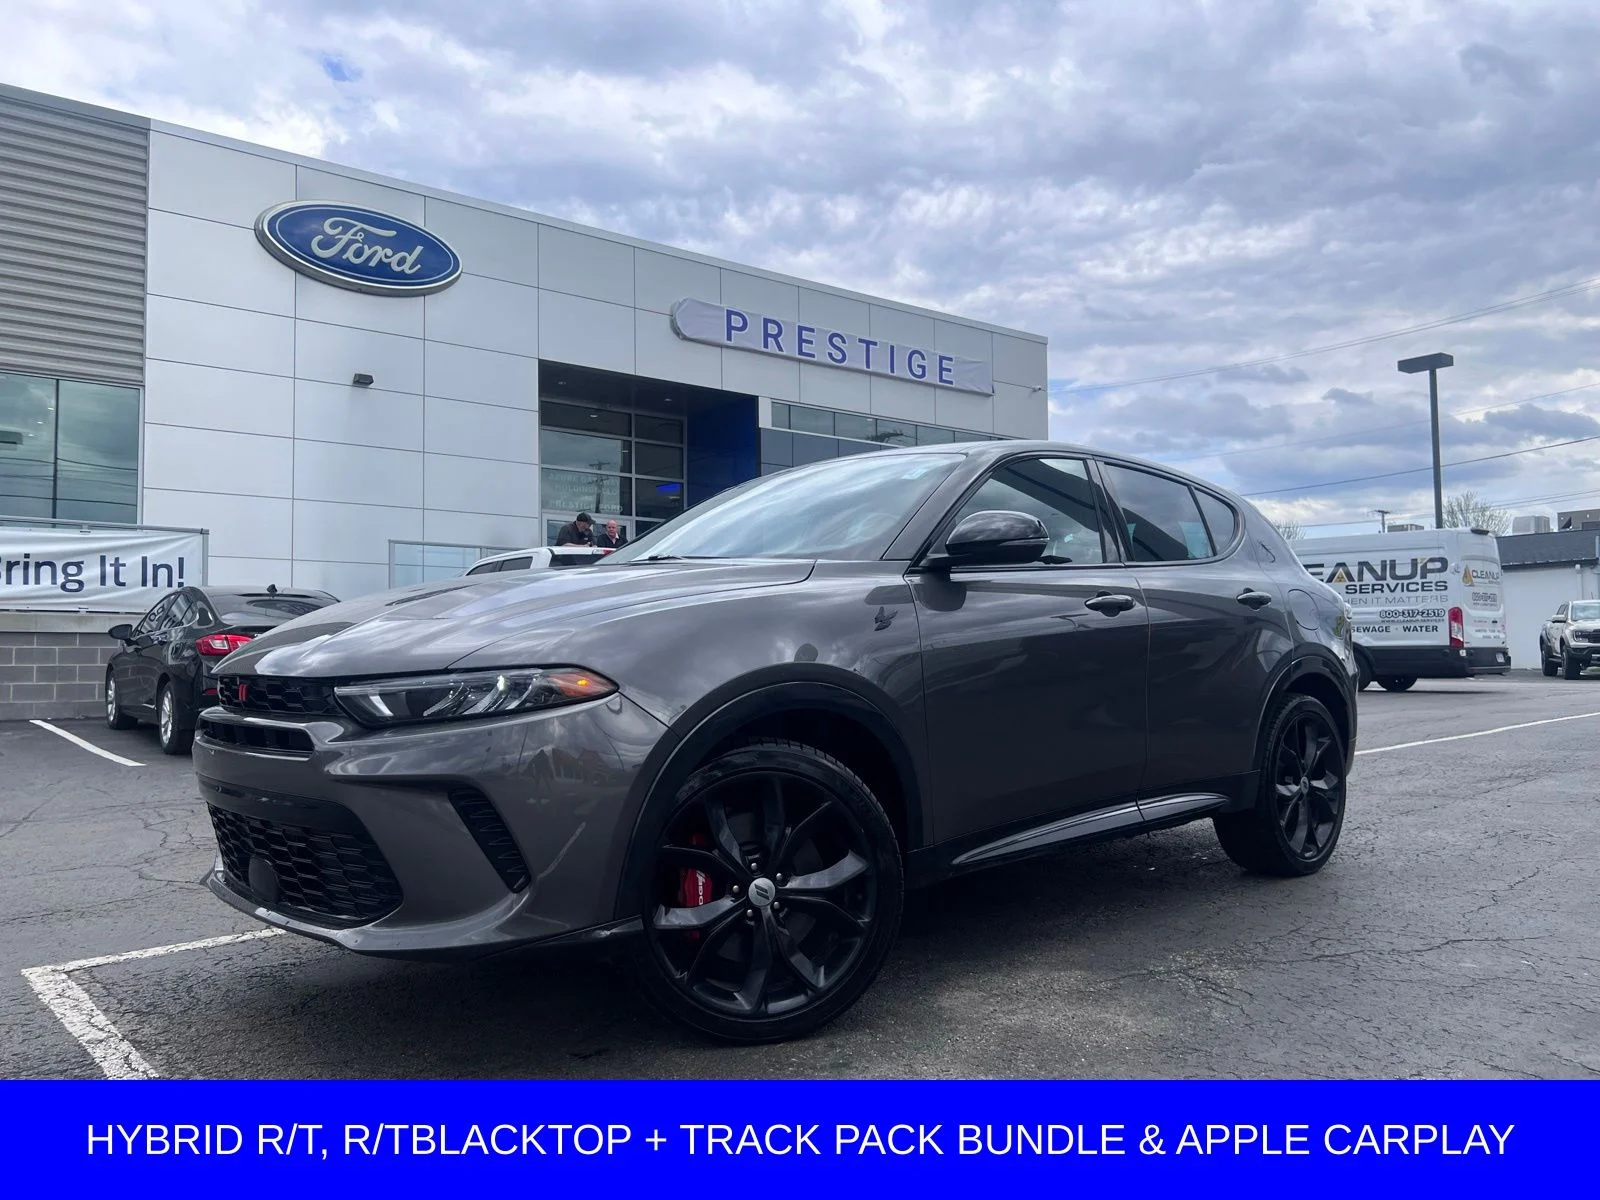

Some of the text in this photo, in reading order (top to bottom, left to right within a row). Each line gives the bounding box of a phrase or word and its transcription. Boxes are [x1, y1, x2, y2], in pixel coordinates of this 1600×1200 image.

[311, 217, 424, 274] Ford
[725, 308, 954, 385] PRESTIGE
[0, 553, 185, 592] ring It In!
[1303, 557, 1449, 583] EANUP
[1345, 580, 1448, 594] SERVICES
[1385, 595, 1448, 604] MATTERS
[1351, 625, 1391, 633] SEWAGE
